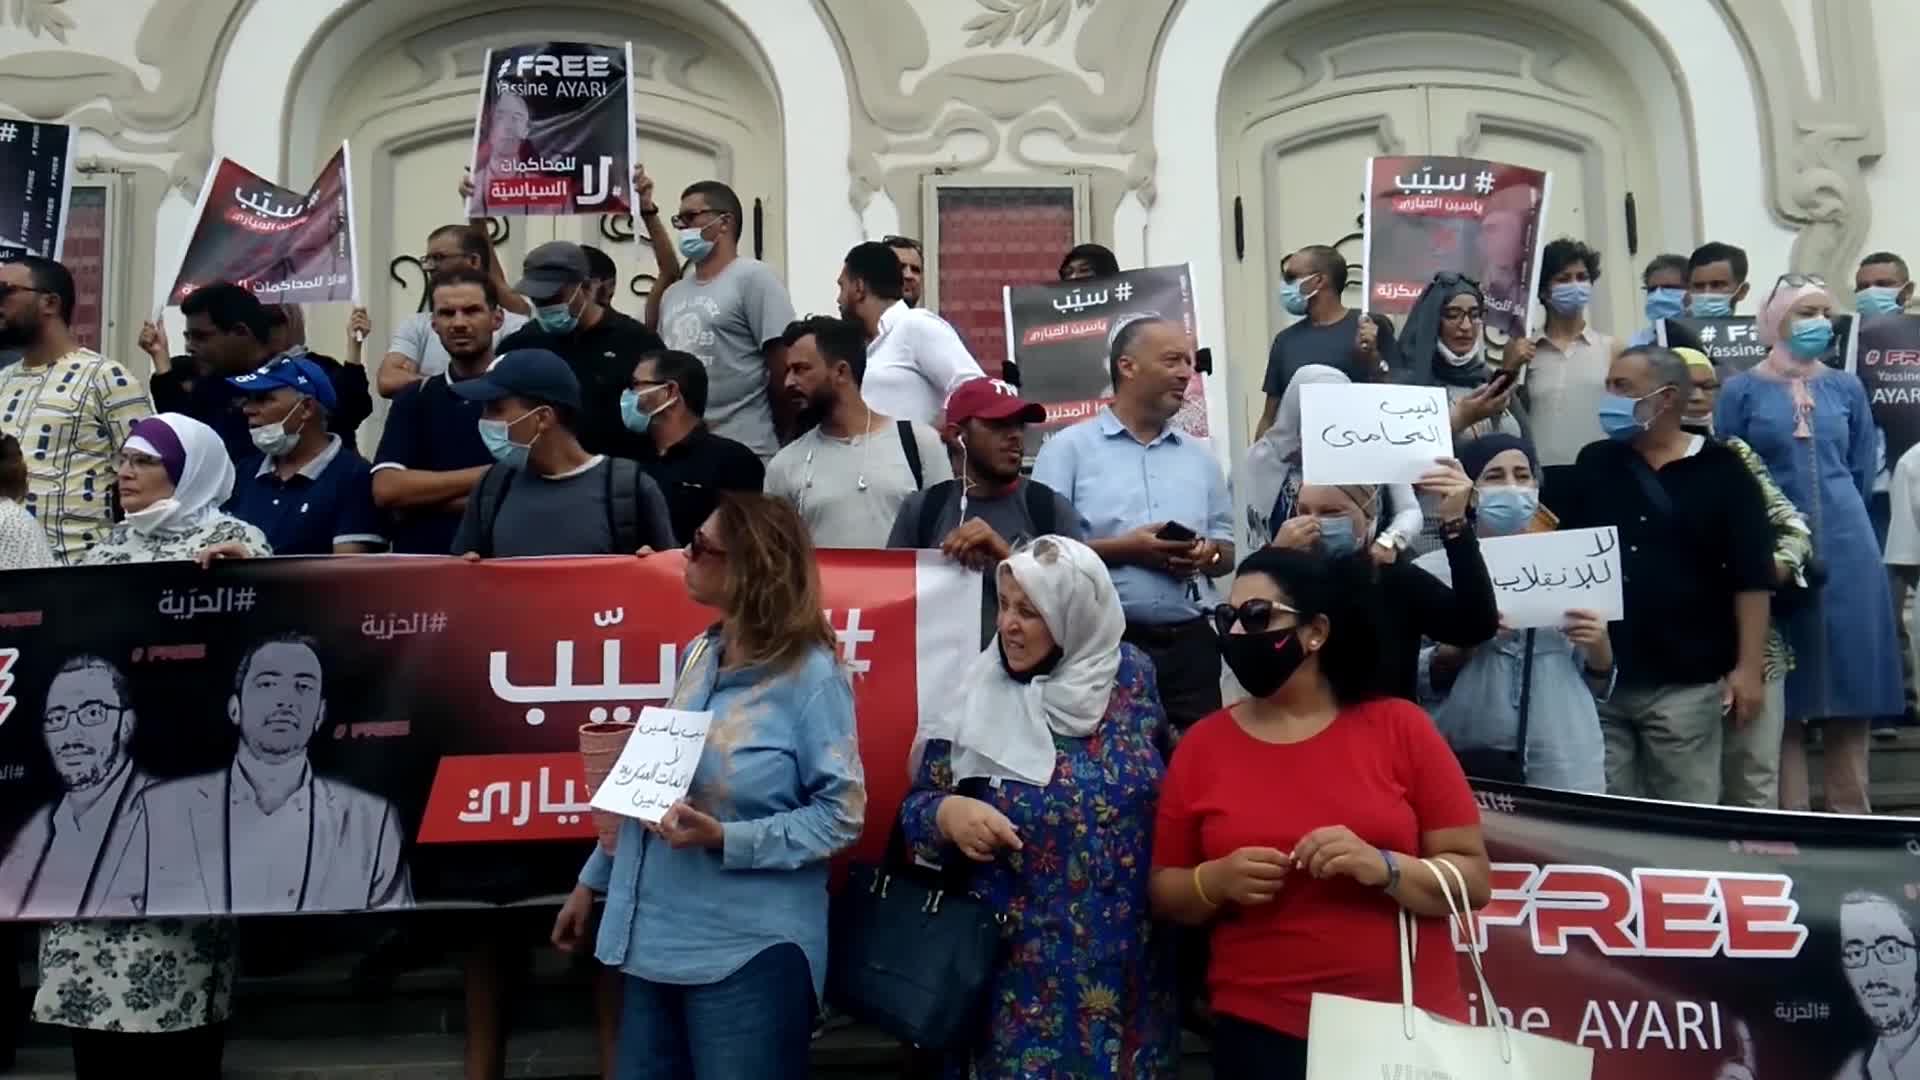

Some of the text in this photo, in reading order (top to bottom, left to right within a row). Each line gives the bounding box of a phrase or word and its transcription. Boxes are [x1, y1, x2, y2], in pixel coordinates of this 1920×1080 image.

[516, 54, 611, 78] FREE
[555, 81, 607, 97] AYARI
[1702, 342, 1766, 358] Yassine
[1885, 349, 1920, 365] FR
[1871, 388, 1920, 403] AYAR
[1585, 528, 1615, 557] لا
[1451, 862, 1811, 958] FREE
[1576, 1000, 1722, 1050] AYARI
